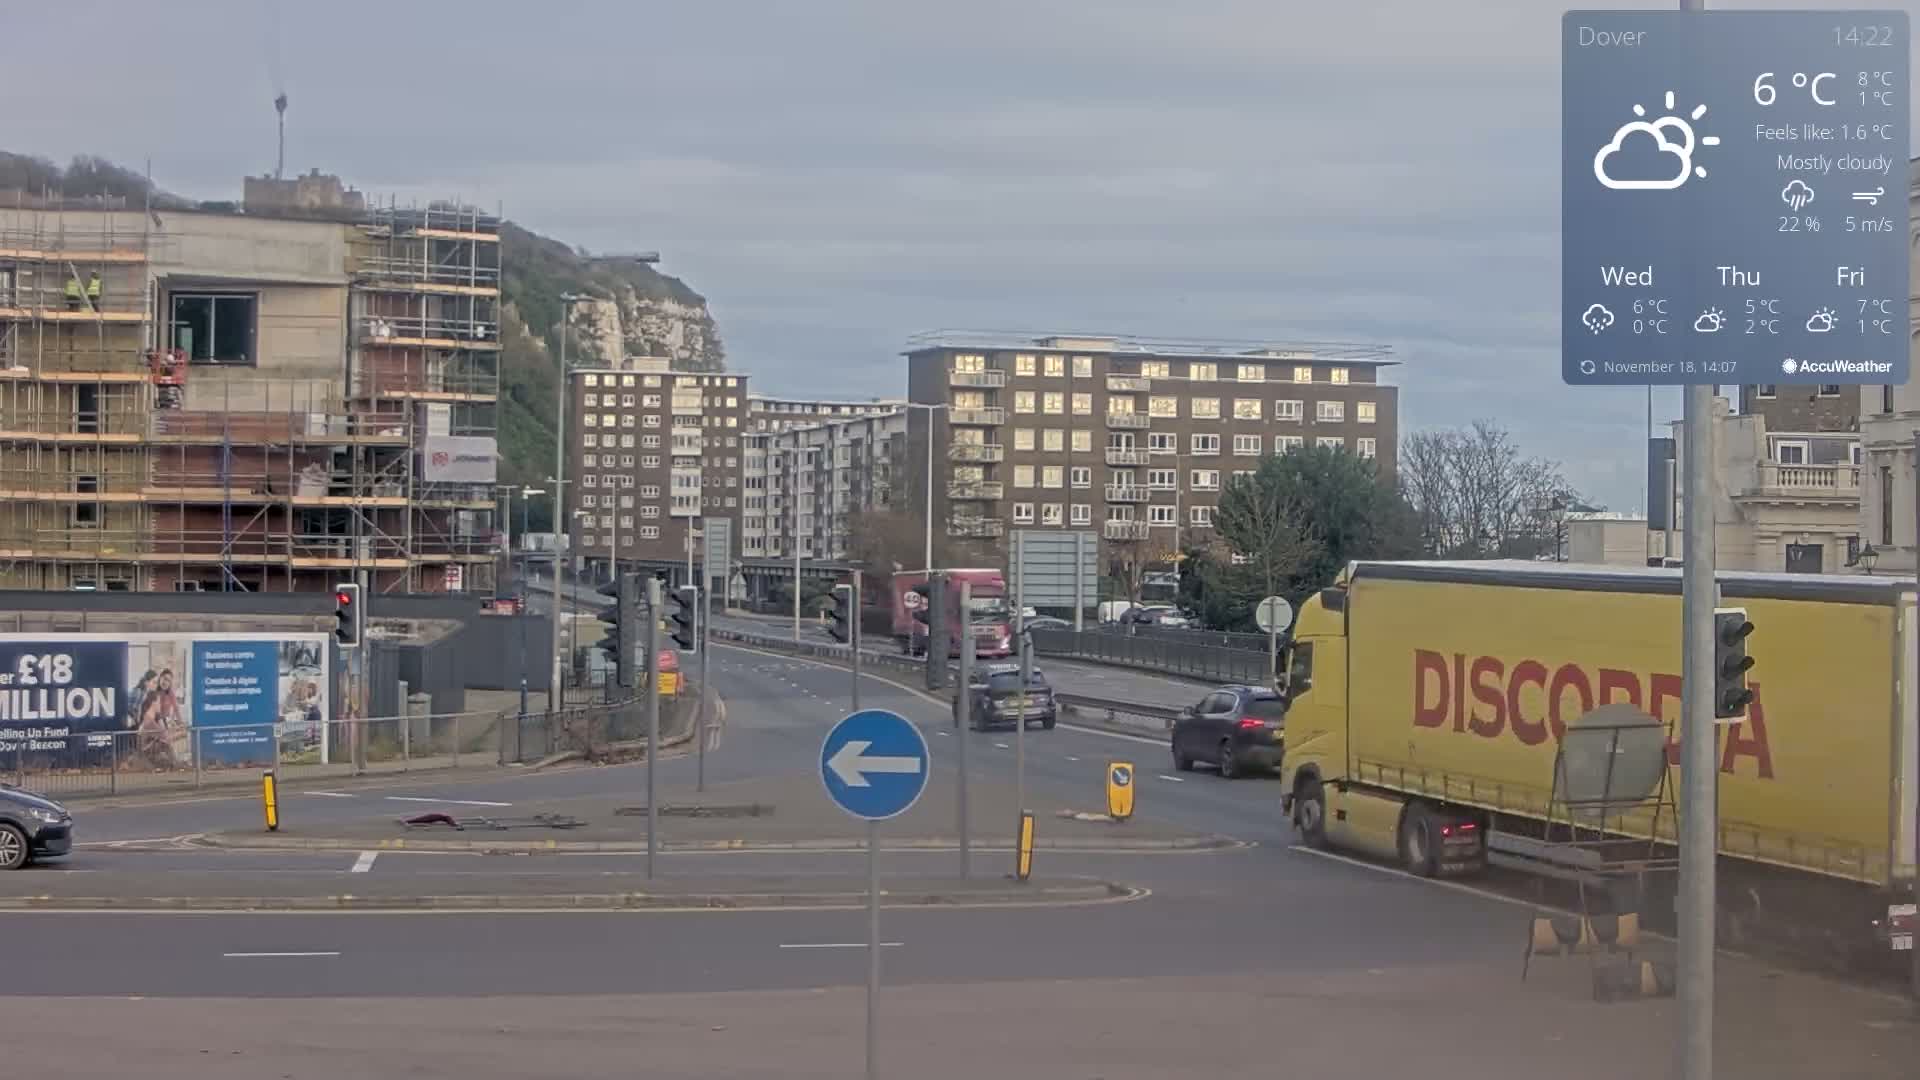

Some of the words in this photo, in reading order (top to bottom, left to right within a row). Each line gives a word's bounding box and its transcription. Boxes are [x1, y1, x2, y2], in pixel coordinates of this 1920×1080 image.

[19, 654, 73, 684] £18
[1413, 648, 1775, 780] DISCOA
[44, 727, 69, 738] Fund
[0, 741, 27, 752] Dovr
[30, 740, 66, 750] Beacon
